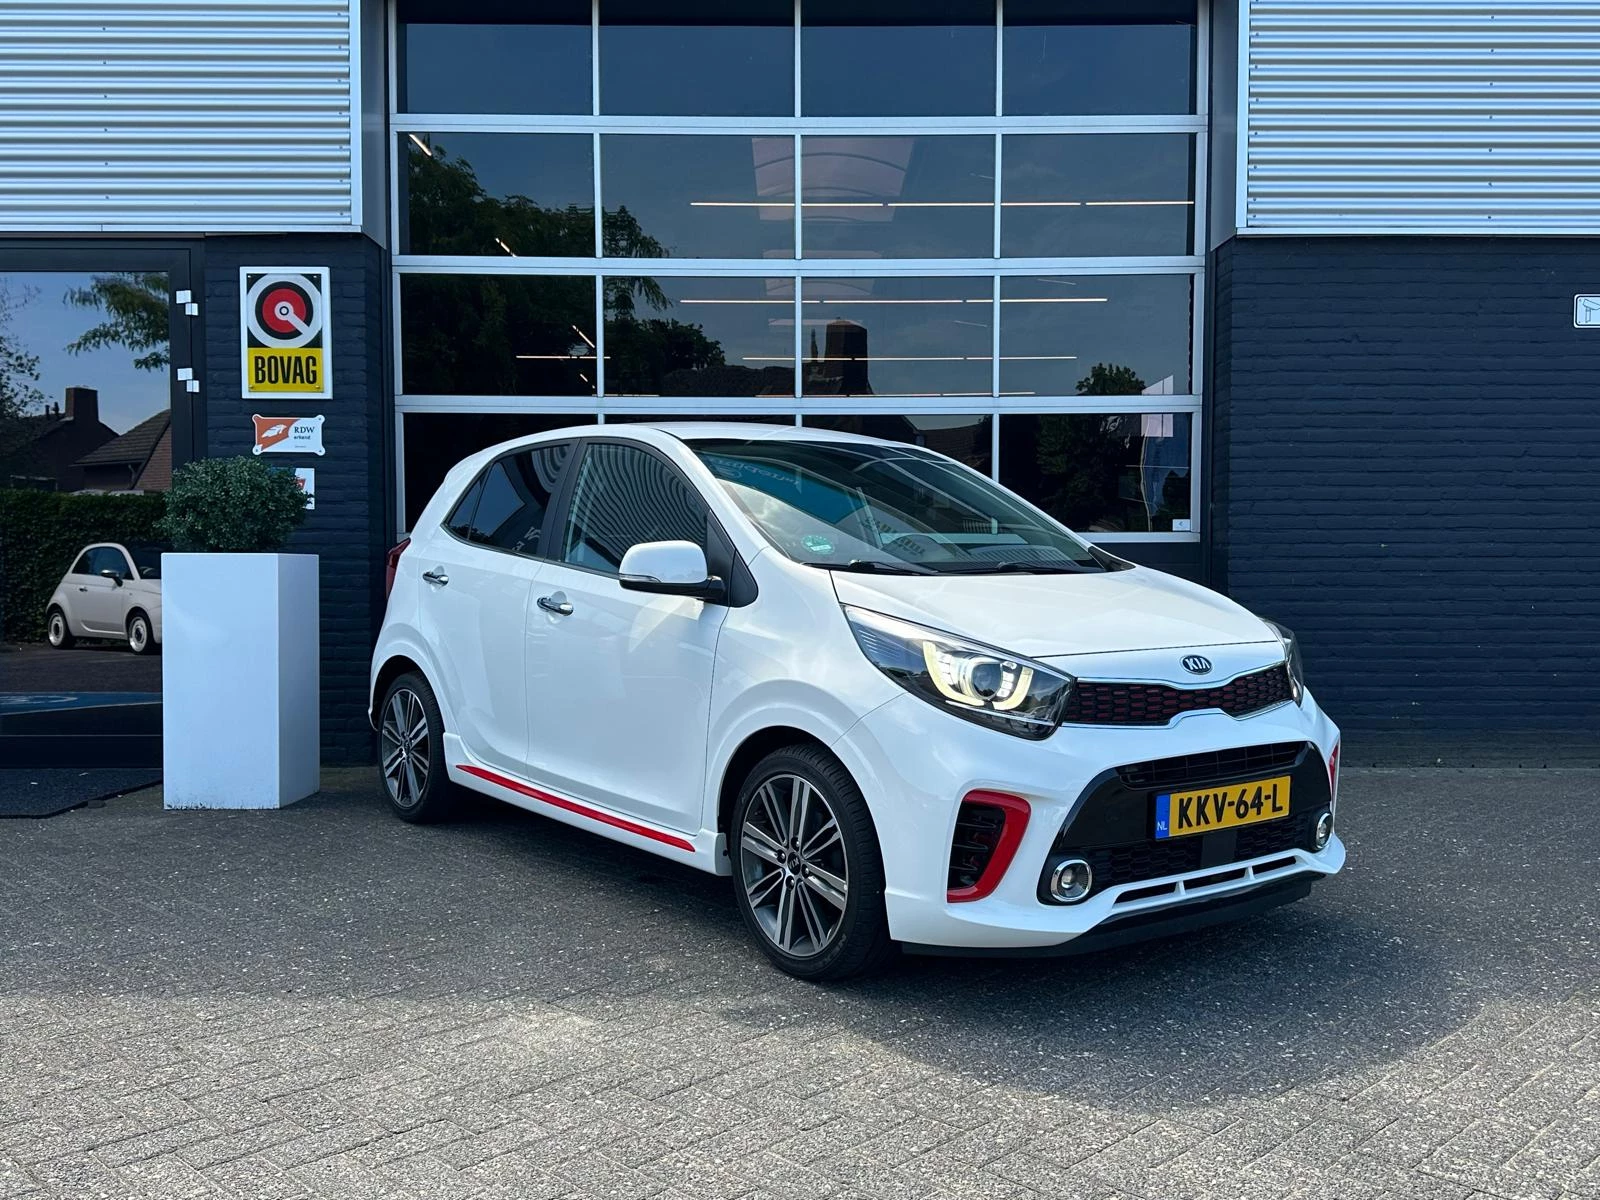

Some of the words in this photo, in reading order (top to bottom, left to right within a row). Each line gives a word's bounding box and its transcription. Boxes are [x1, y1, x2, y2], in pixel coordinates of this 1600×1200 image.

[254, 355, 318, 385] BOVAG
[294, 426, 315, 434] RDW
[1184, 657, 1211, 670] KIA
[1177, 784, 1284, 830] KKV-64-L
[1156, 821, 1168, 832] NL
